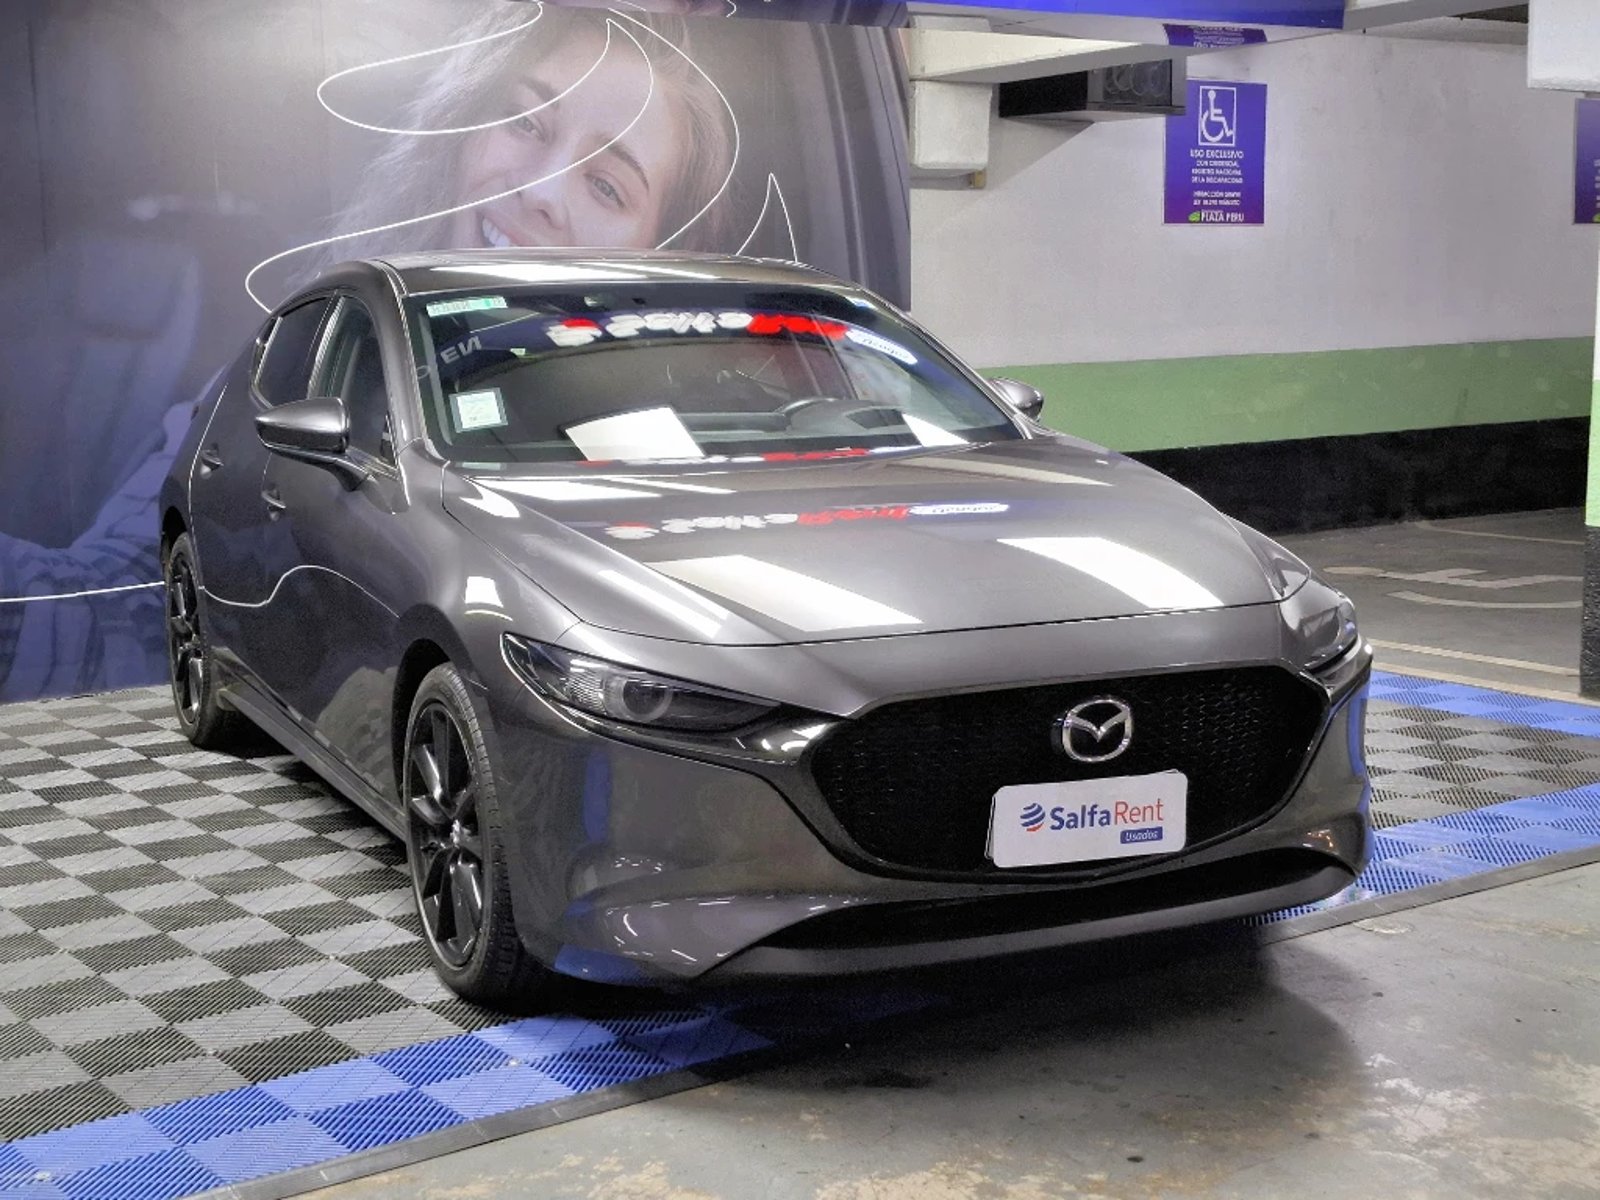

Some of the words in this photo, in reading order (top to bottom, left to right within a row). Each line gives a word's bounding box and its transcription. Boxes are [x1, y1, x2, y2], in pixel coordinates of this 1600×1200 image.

[1190, 149, 1204, 158] USO
[1206, 149, 1244, 159] EXCLUSIVO
[1201, 211, 1224, 222] PLAZA
[1050, 798, 1164, 830] SalfaRent
[1125, 830, 1159, 843] Usados
